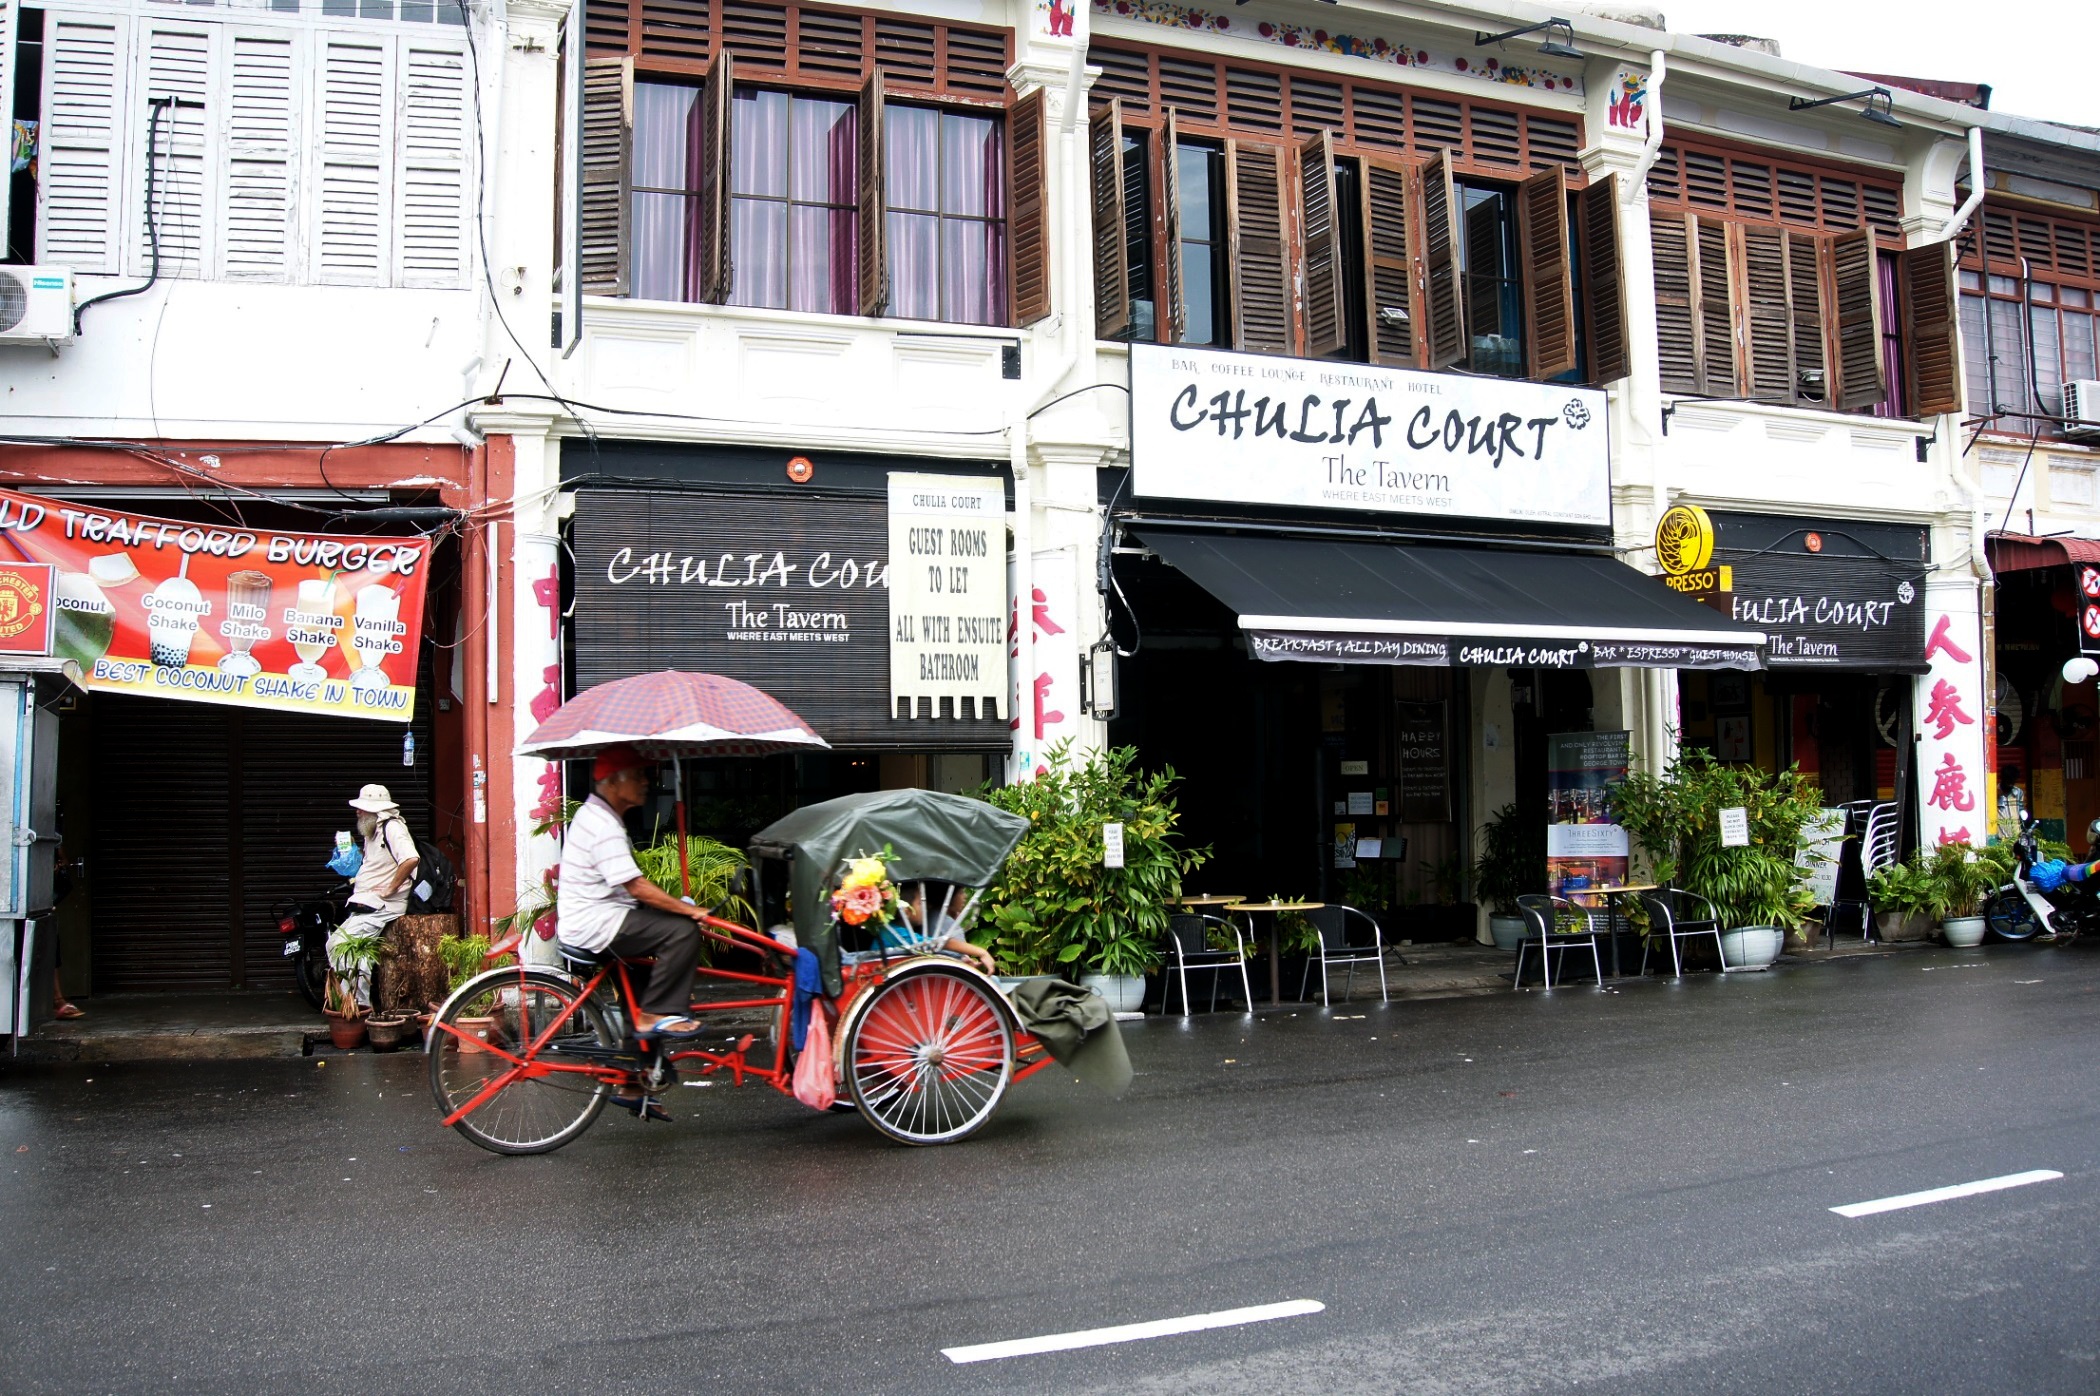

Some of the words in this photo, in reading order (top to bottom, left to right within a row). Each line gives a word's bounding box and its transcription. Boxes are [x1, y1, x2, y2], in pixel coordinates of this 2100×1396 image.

[1171, 358, 1201, 375] BAR
[1211, 363, 1255, 377] COFFEE
[1261, 367, 1306, 385] LOUNGE
[1319, 373, 1395, 392] RESTAURANT
[1408, 381, 1442, 395] HOTEL
[1170, 383, 1392, 448] CHULIA
[1406, 405, 1559, 469] COURT
[1322, 453, 1367, 487] The
[1372, 460, 1450, 492] Tavern
[912, 494, 947, 508] CHULIA
[951, 496, 982, 510] COURT
[1322, 489, 1360, 502] WHERE
[1361, 491, 1386, 503] EAST
[1389, 493, 1424, 505] MEETS
[1426, 496, 1453, 508] WEST
[59, 508, 257, 558] TRAFFORD
[267, 535, 421, 576] BURGER
[909, 527, 944, 556] GUEST
[950, 528, 987, 557] ROOMS
[607, 546, 797, 587] CHULIA
[928, 565, 942, 593] TO
[949, 567, 968, 594] LET
[143, 595, 210, 614] Coconut
[232, 604, 264, 619] Milo
[725, 599, 768, 628] The
[772, 603, 848, 630] Tavern
[1815, 597, 1895, 632] COURT
[149, 615, 197, 631] Shake
[285, 610, 342, 627] Banana
[354, 616, 404, 634] Vanilla
[222, 622, 269, 639] Shake
[288, 629, 335, 645] Shake
[727, 631, 761, 641] WHERE
[763, 631, 788, 641] EAST
[789, 632, 821, 641] MEETS
[823, 633, 850, 642] WEST
[896, 614, 915, 643] ALL
[922, 615, 950, 643] WITH
[957, 616, 1002, 644] ENSUITE
[354, 636, 401, 652] Shake
[1253, 636, 1335, 652] BREAKFAST
[1344, 642, 1372, 653] ALL
[1374, 642, 1400, 659] DAY
[1402, 641, 1447, 660] DINING
[1594, 646, 1616, 660] BAR
[1626, 647, 1680, 660] ESPRESSO
[1769, 634, 1793, 655] The
[1796, 636, 1838, 656] Tavern
[920, 653, 979, 681] BATHROOM
[1460, 646, 1525, 665] CHULIA
[1528, 649, 1578, 668] COURT
[94, 659, 150, 683] BEST
[156, 668, 249, 693] COCONUT
[254, 677, 318, 701] SHAKE
[324, 684, 344, 702] IN
[352, 686, 408, 709] TOWN
[1402, 747, 1441, 759] HOURS
[1345, 764, 1364, 772] OPEN
[1804, 860, 1827, 869] DINNER
